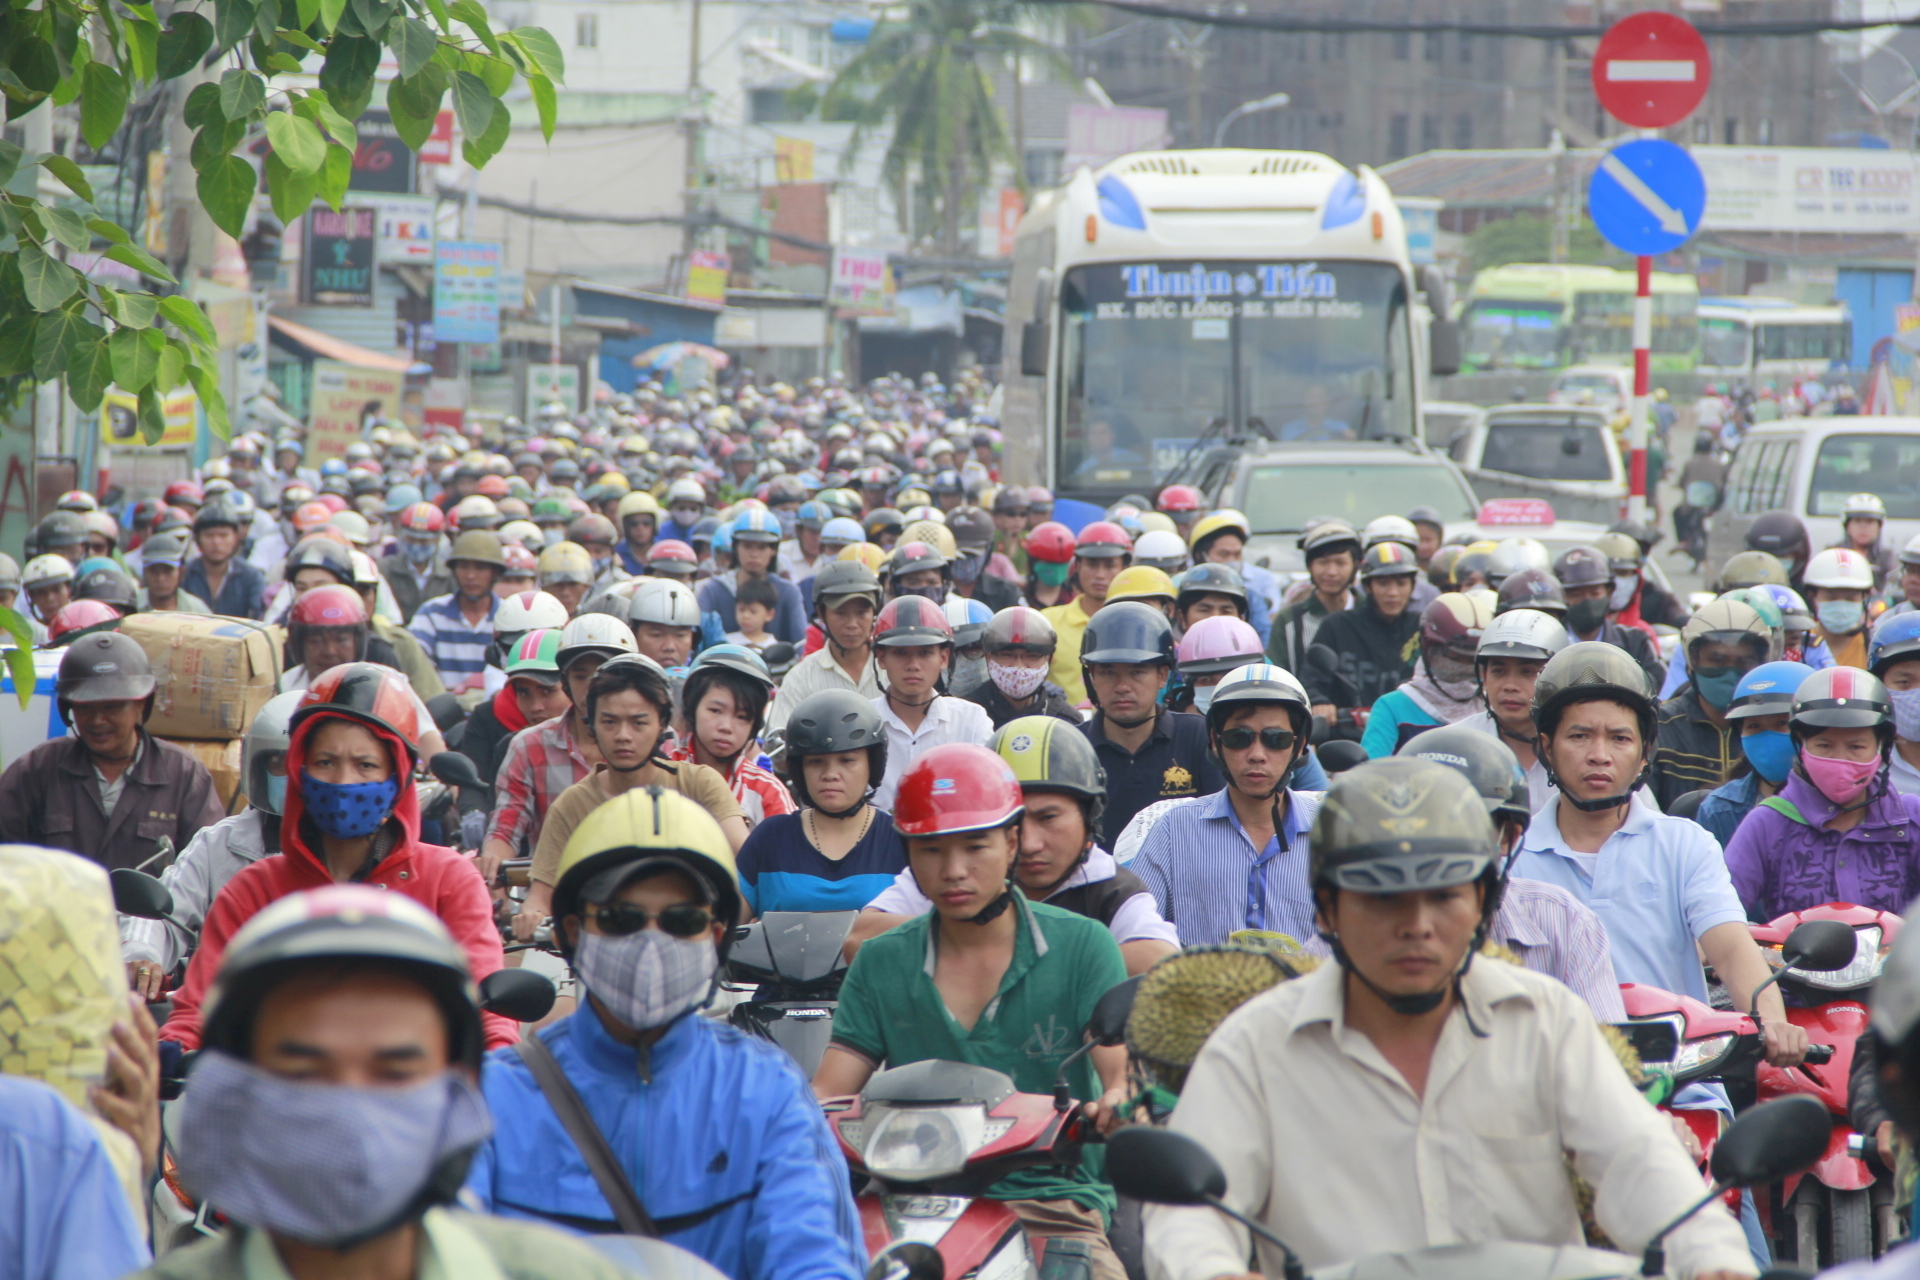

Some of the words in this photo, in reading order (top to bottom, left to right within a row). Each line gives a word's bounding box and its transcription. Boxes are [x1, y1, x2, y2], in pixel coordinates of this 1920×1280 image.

[1121, 263, 1233, 302] Thuận
[1256, 261, 1337, 298] Tiến
[1416, 752, 1469, 768] HONDA
[785, 1009, 827, 1017] HONDA
[1826, 1006, 1867, 1016] HONDA
